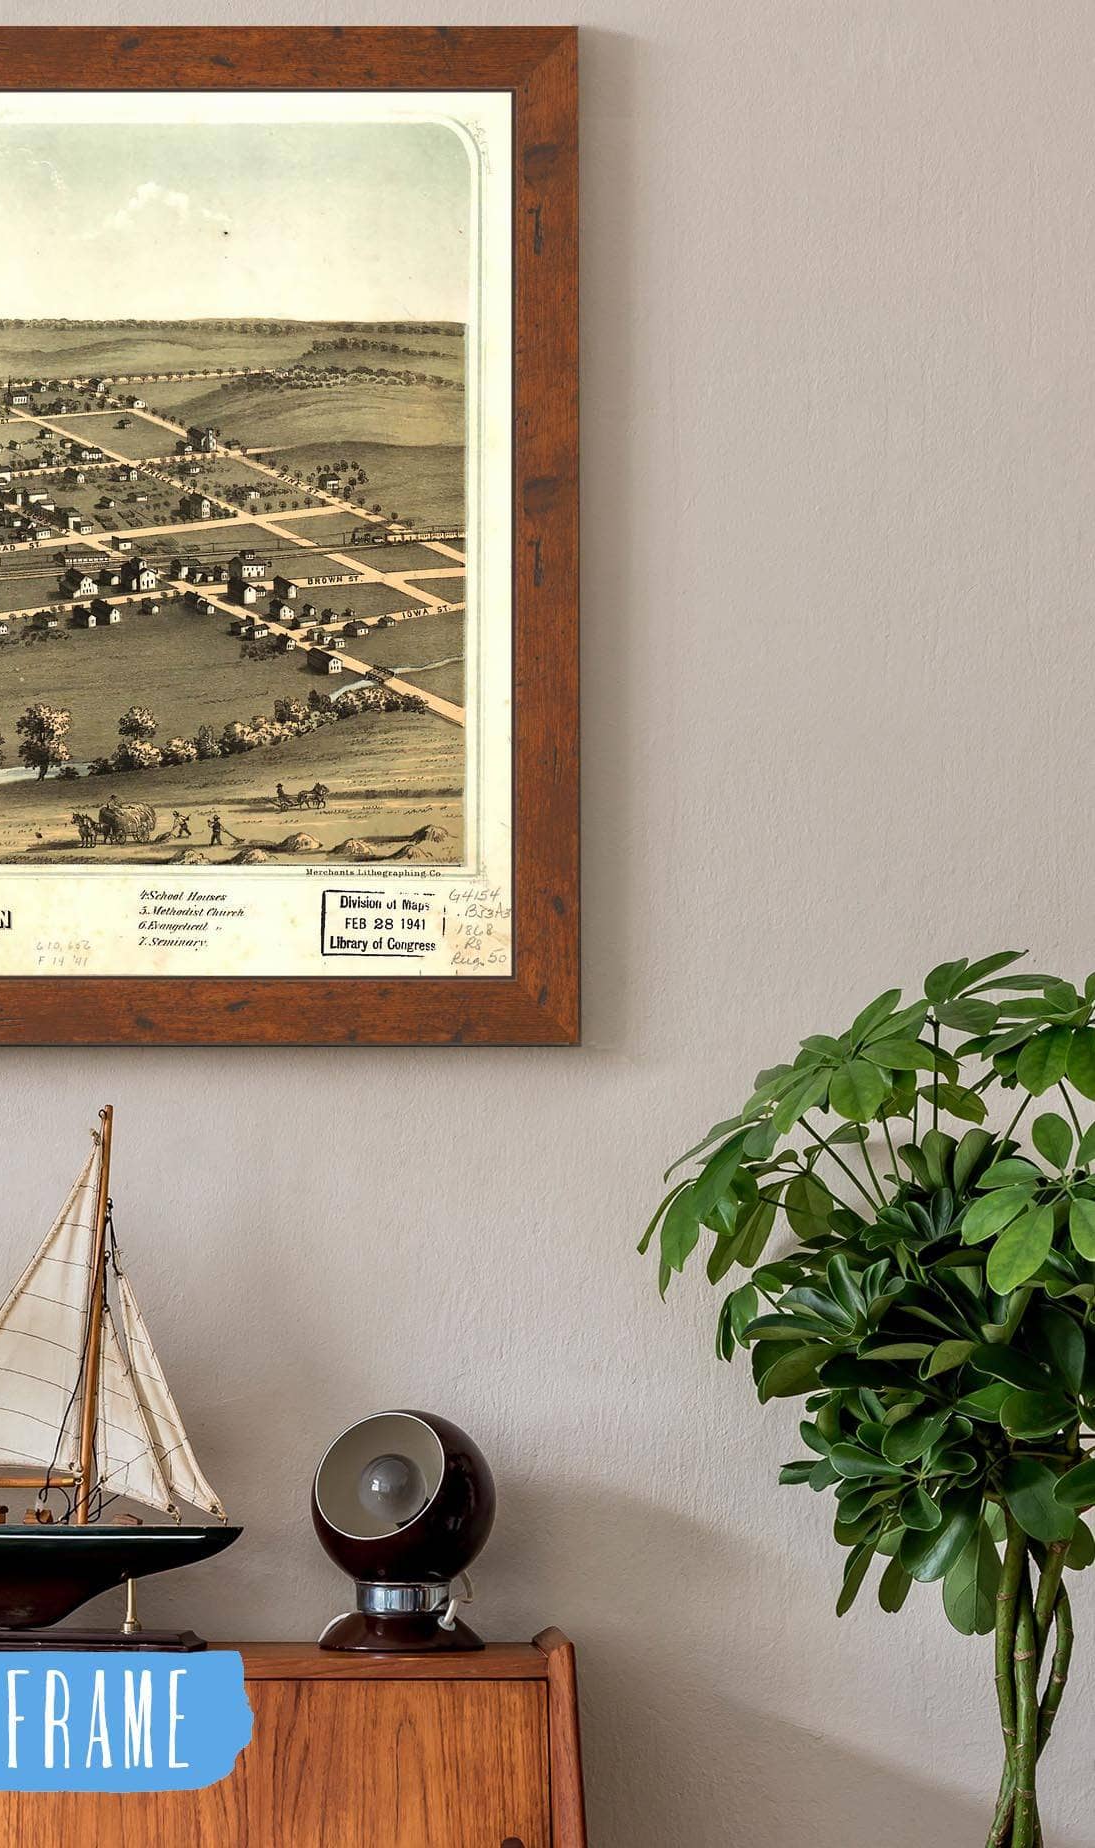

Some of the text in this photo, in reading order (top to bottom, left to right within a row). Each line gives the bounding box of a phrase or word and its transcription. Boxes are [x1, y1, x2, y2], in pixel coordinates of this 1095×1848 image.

[307, 576, 343, 585] BROWN
[402, 609, 429, 618] IOWA
[305, 868, 355, 876] Merchants
[358, 869, 427, 878] Lithographing
[187, 892, 227, 901] Houses
[340, 894, 381, 909] Division
[403, 899, 430, 912] Maps
[207, 907, 245, 916] Church
[345, 918, 425, 930] FEB 28 1941
[330, 936, 437, 952] Library of Congress
